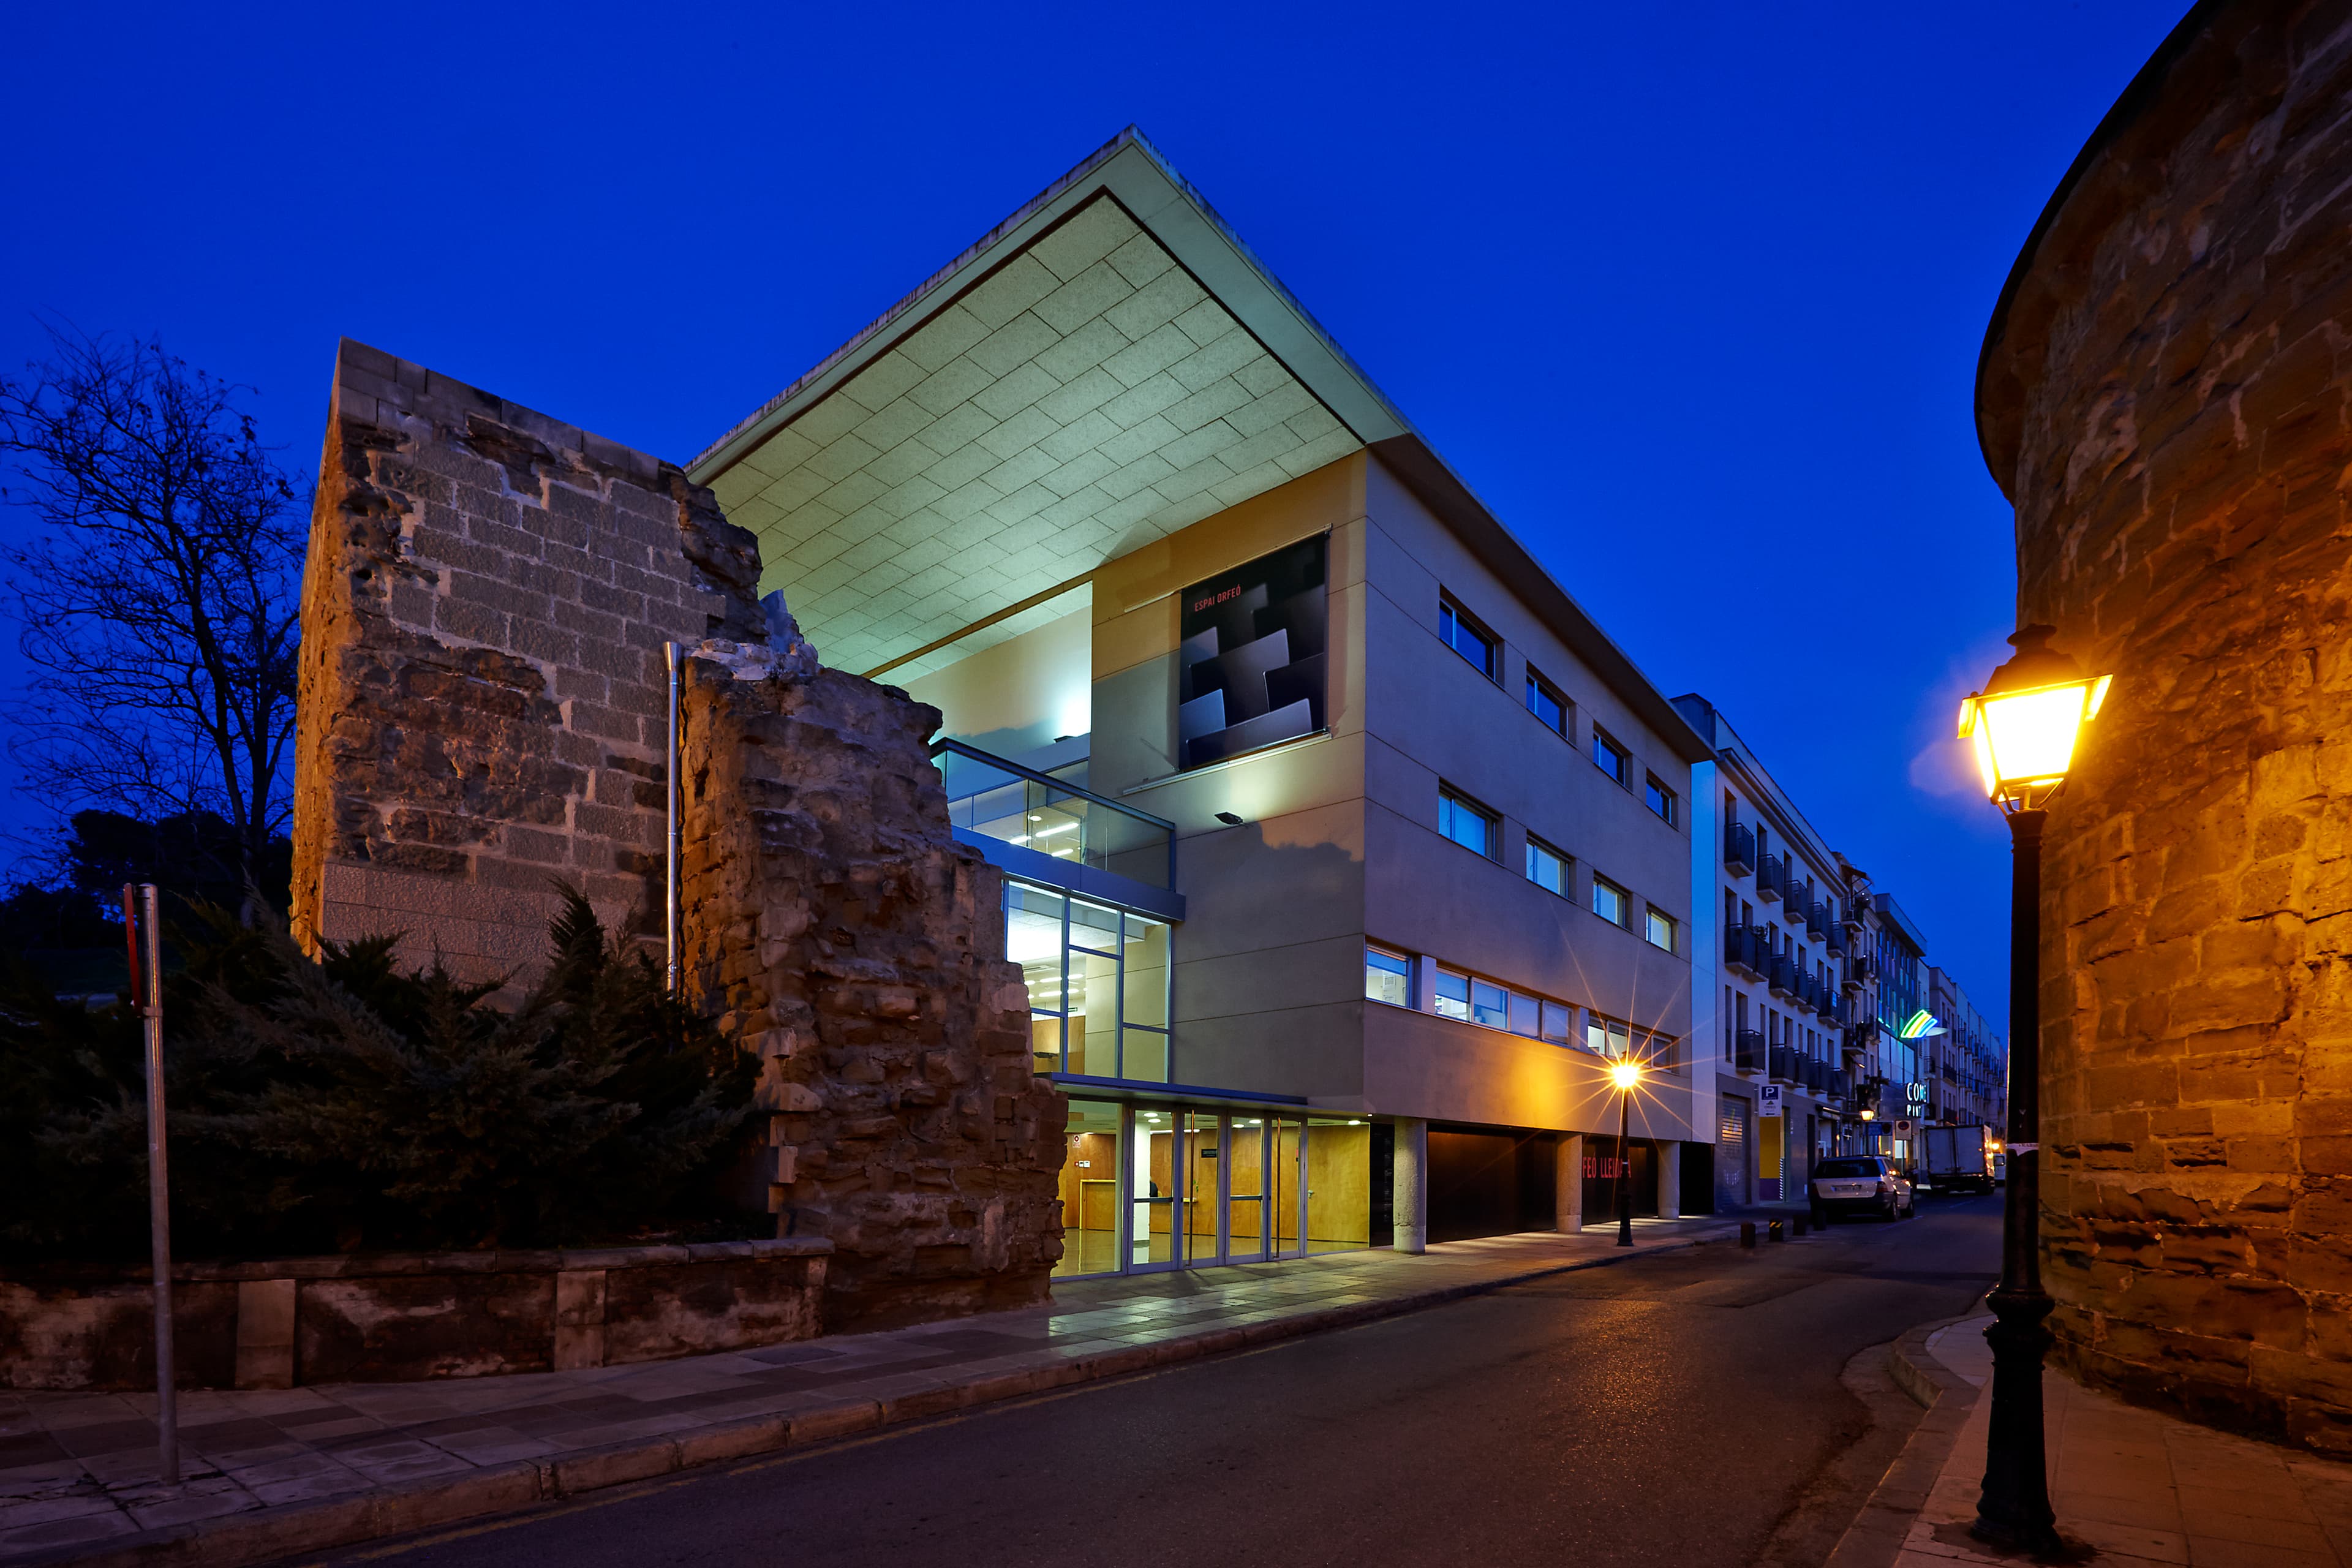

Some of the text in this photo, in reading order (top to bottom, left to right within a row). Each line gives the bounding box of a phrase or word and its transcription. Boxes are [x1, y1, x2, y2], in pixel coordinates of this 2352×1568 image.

[1195, 584, 1241, 612] ESPAI ORFEÓ
[1765, 1087, 1774, 1097] P
[1583, 1152, 1597, 1178] FEÓ
